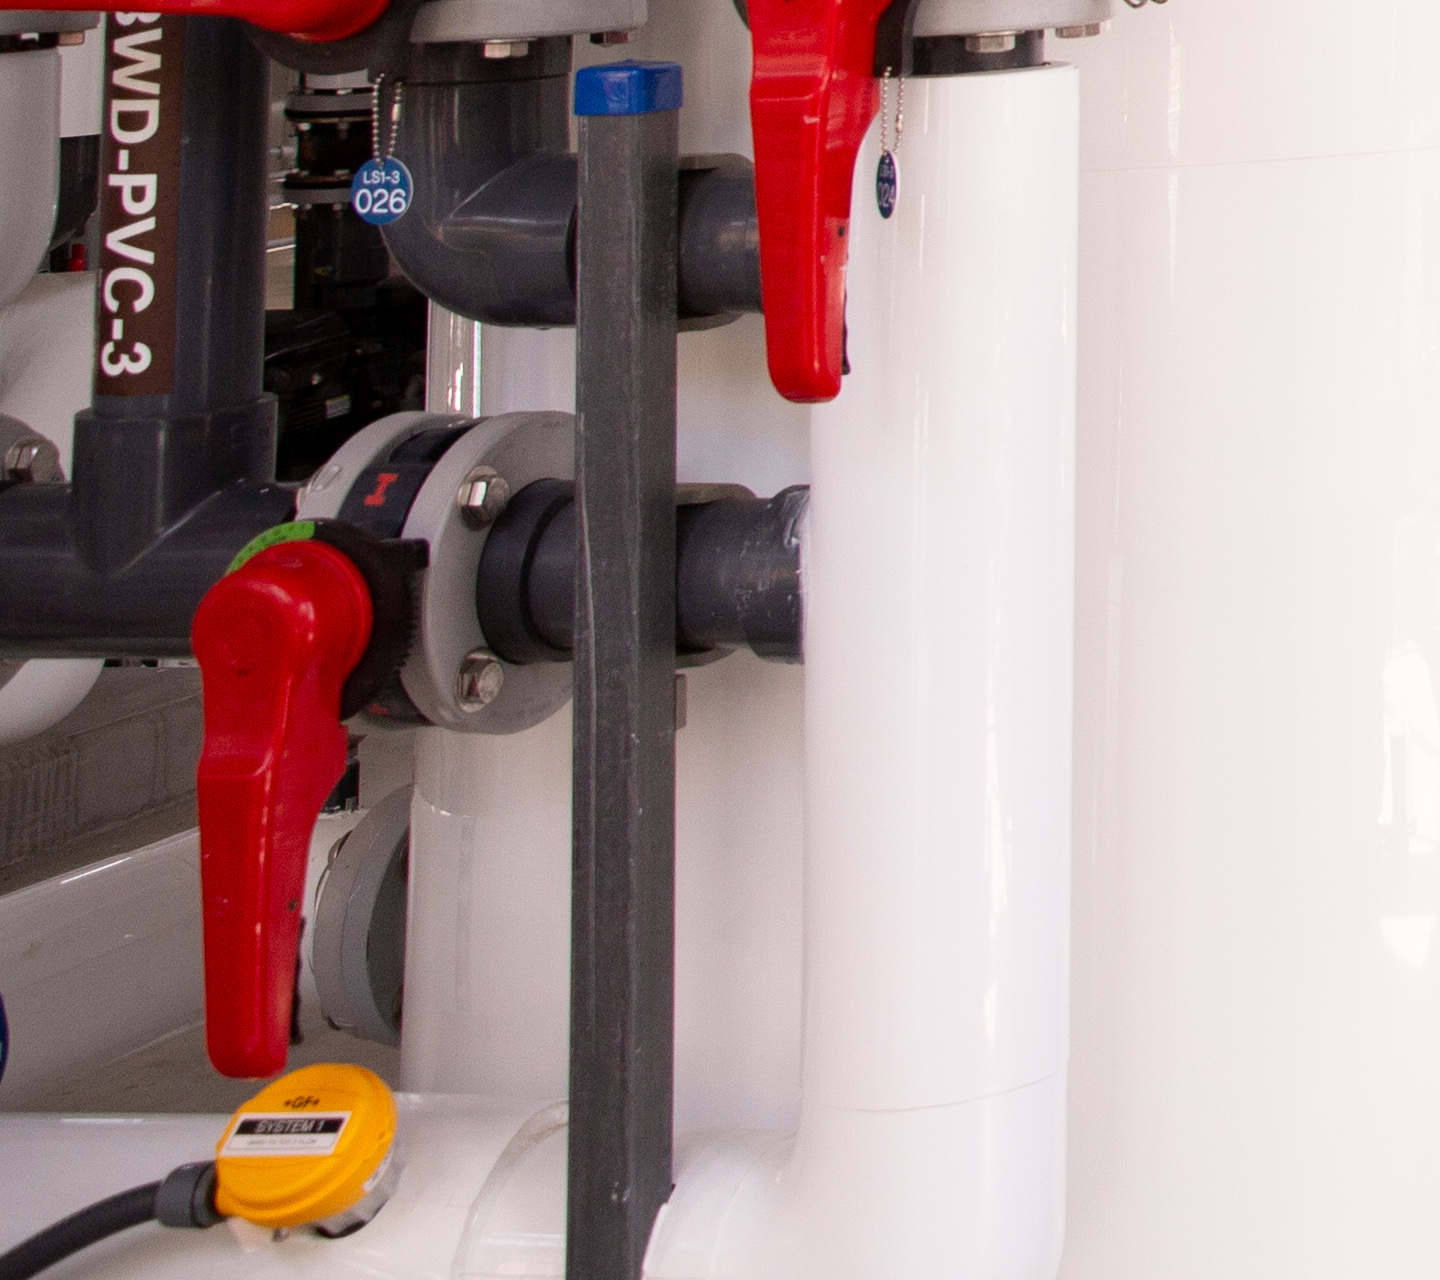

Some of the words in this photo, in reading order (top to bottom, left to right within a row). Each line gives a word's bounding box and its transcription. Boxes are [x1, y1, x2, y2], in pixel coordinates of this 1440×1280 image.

[363, 170, 401, 184] LS1-3
[354, 188, 407, 215] 026
[254, 1119, 314, 1134] SYSTEM
